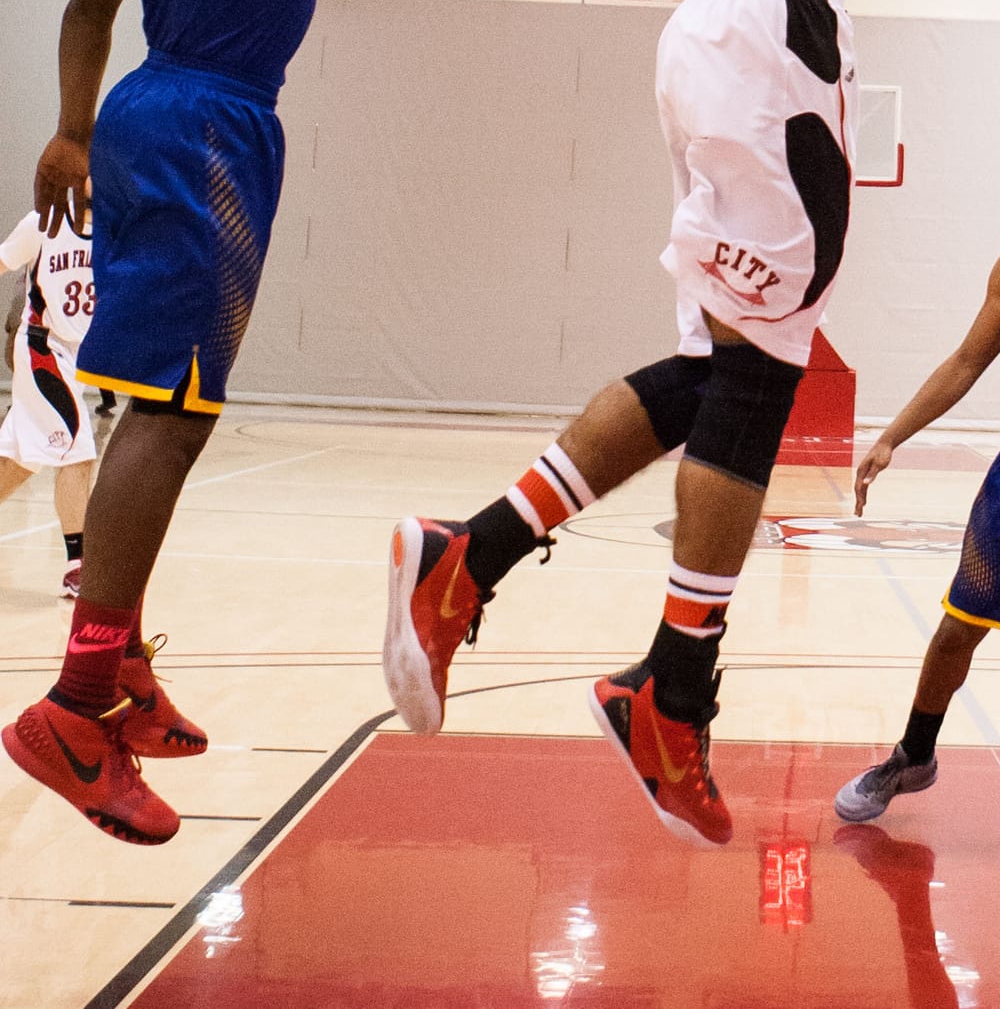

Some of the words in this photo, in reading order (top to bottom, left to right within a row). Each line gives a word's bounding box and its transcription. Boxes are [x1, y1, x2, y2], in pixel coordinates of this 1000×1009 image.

[49, 252, 69, 274] SAN
[72, 249, 92, 269] FRA
[715, 241, 781, 292] CITY
[62, 280, 97, 317] 33
